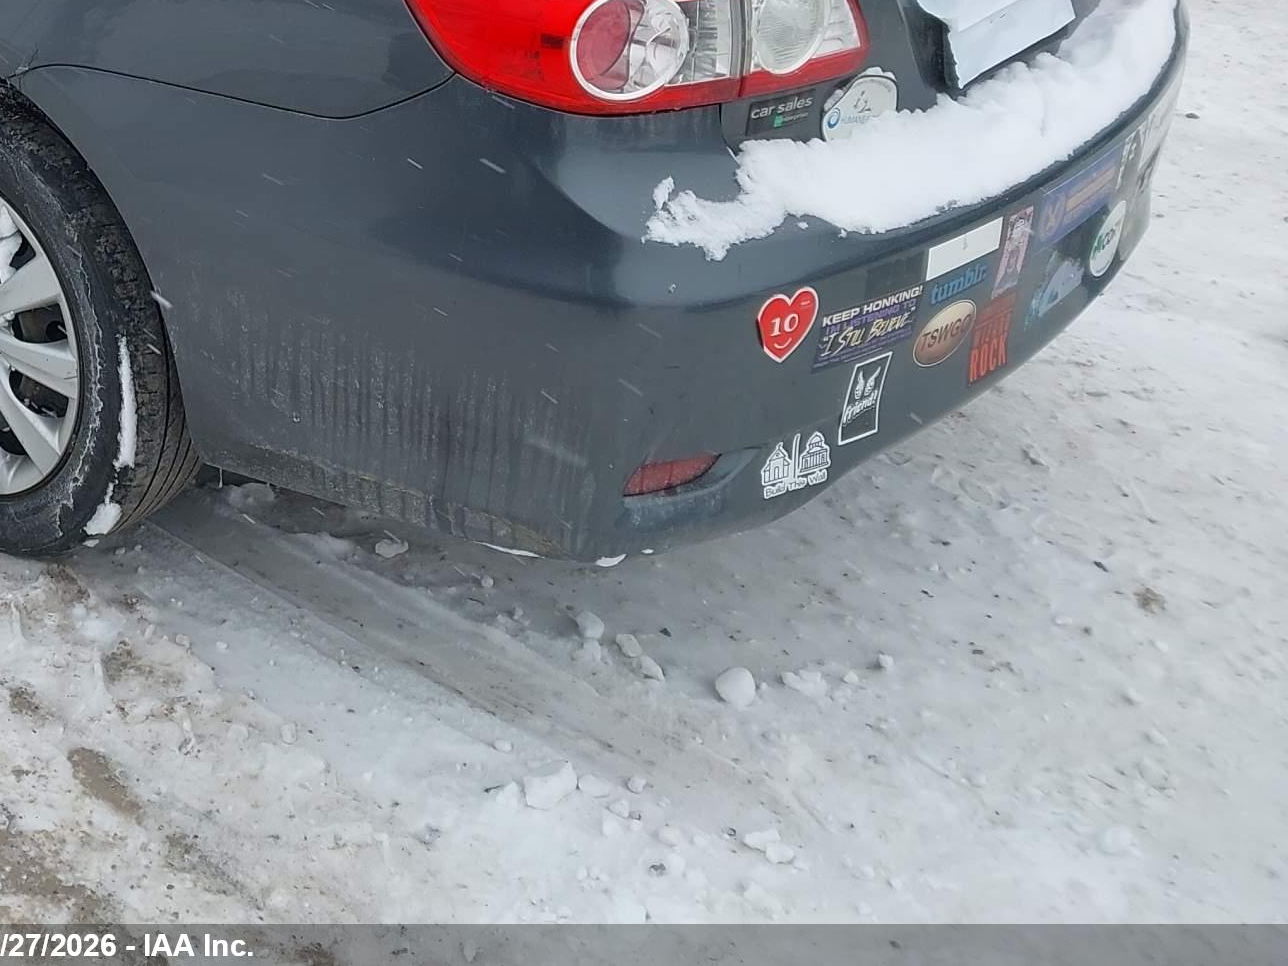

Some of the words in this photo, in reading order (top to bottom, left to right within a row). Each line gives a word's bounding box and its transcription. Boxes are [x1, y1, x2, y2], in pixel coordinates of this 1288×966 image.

[750, 106, 774, 119] car
[776, 96, 813, 113] sales
[822, 307, 861, 327] KEEP
[863, 285, 924, 315] HONKING!
[770, 313, 799, 337] 10
[969, 333, 1008, 384] ROCK
